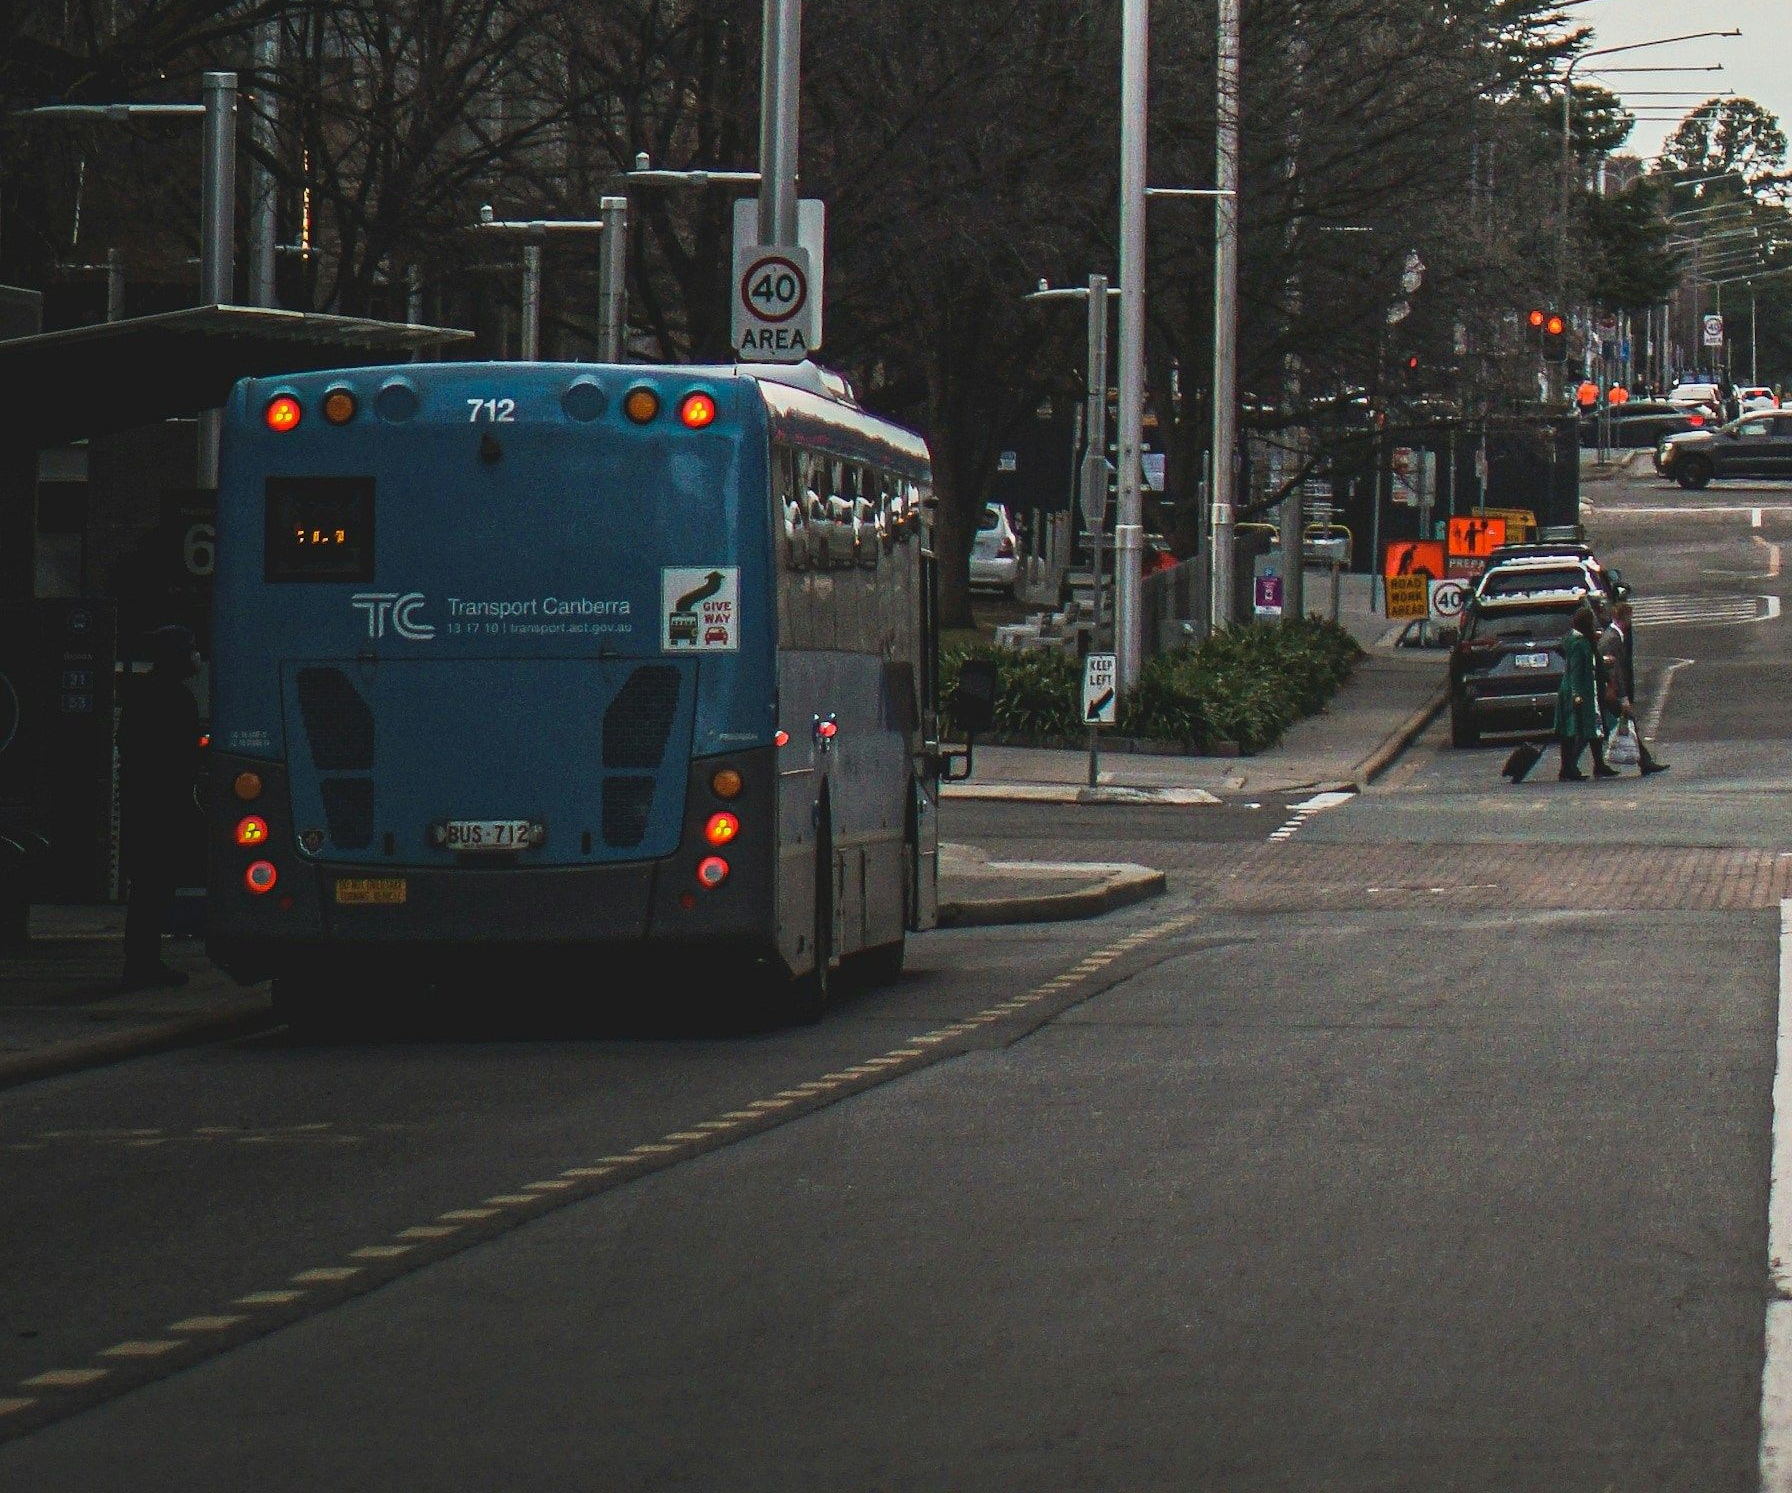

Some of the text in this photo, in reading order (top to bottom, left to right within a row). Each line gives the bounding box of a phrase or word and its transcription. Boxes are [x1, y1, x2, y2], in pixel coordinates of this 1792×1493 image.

[752, 274, 796, 303] 40
[742, 328, 806, 350] AREA
[466, 398, 515, 423] 712
[184, 523, 216, 576] 6
[447, 597, 632, 619] Transport Canberra
[703, 601, 732, 612] GIVE
[1438, 592, 1461, 608] 40
[352, 592, 436, 640] TC
[704, 613, 731, 624] WAY
[448, 622, 462, 634] 13
[467, 622, 480, 634] 17
[486, 622, 499, 634] 10
[1090, 660, 1113, 671] KEEP
[1090, 675, 1112, 685] LEFT
